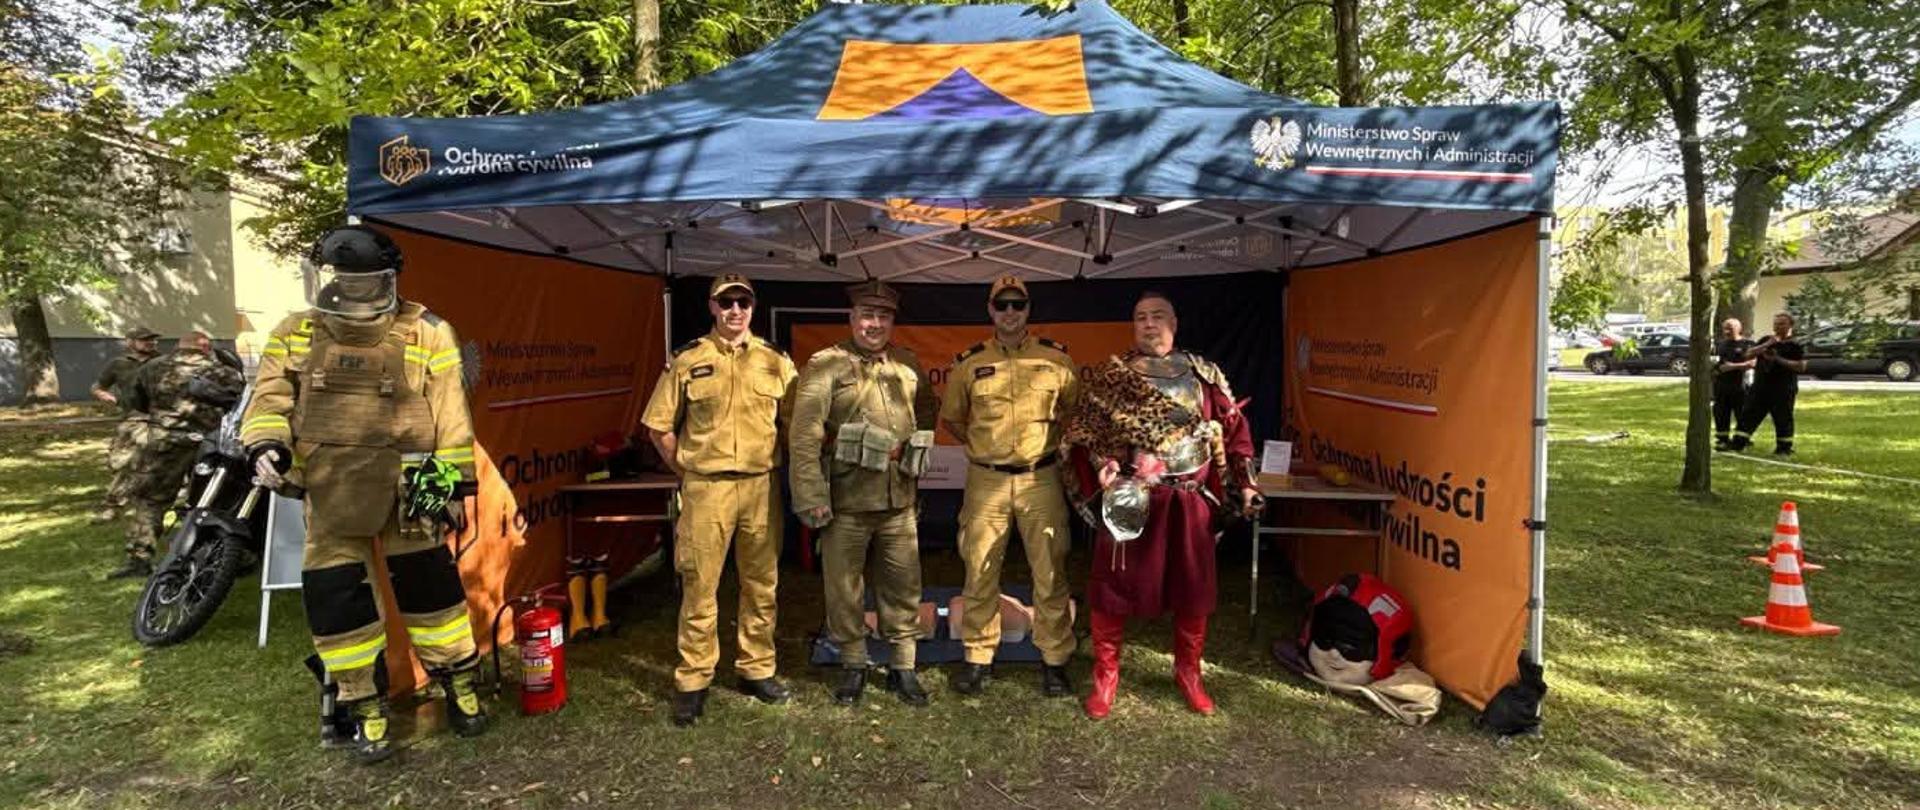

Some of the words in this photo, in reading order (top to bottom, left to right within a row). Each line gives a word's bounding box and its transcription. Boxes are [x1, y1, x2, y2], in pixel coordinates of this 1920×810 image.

[1306, 121, 1409, 142] Ministerstwo
[1412, 127, 1461, 144] Spraw
[1306, 142, 1423, 161] Wewnętrznych
[1425, 149, 1430, 160] i
[1434, 147, 1535, 165] Administracji
[1383, 512, 1461, 572] wilna
